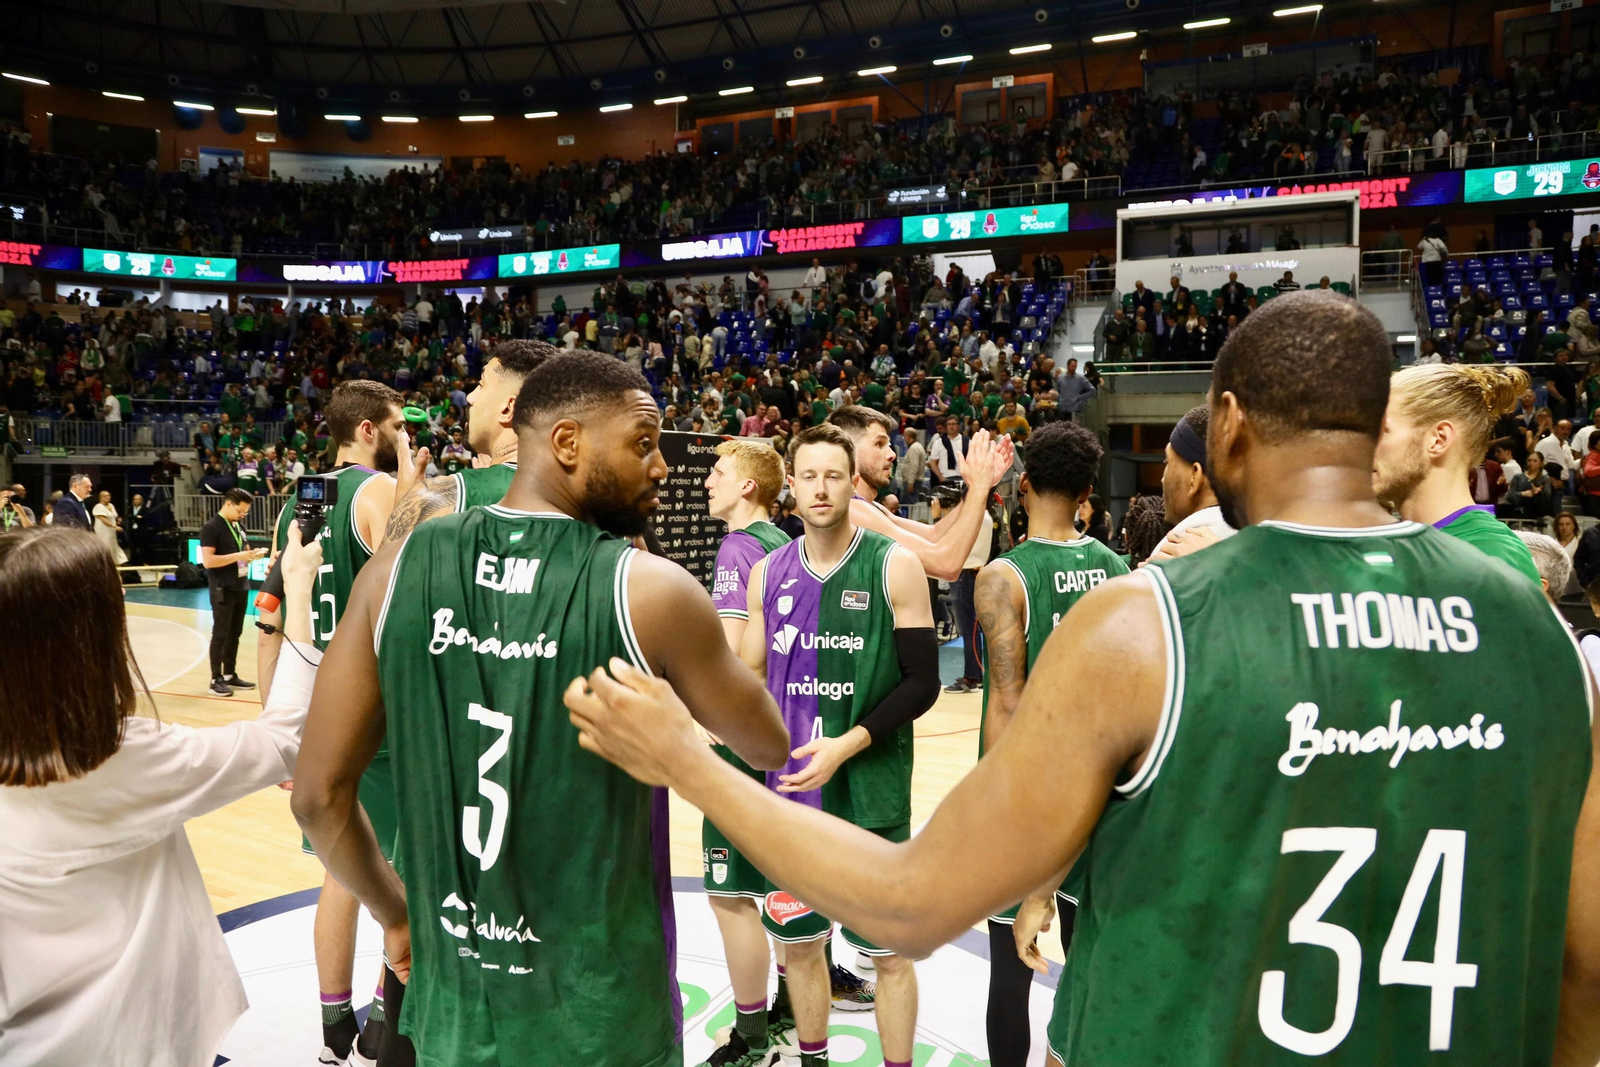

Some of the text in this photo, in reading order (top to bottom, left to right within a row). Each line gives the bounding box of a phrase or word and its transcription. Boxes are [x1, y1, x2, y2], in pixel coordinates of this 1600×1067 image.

[1527, 161, 1571, 177] JORNADA
[1533, 171, 1564, 196] 29
[1020, 214, 1037, 223] liga
[1020, 221, 1056, 231] endesa
[769, 222, 865, 243] CASADEMONT
[950, 219, 971, 240] 29
[661, 237, 745, 261] UNICAJA
[776, 233, 856, 253] ZARAGOZA
[282, 264, 366, 282] UNICAJA
[388, 258, 470, 273] CASADEMONT
[394, 269, 463, 283] ZARAGOZA
[688, 465, 708, 474] endesa
[686, 502, 706, 510] endesa
[668, 514, 689, 523] endesa
[684, 538, 705, 547] endesa
[475, 551, 541, 595] EJIM
[1054, 568, 1107, 594] CARTER
[1291, 592, 1479, 653] THOMAS
[800, 632, 864, 654] Unicaja
[462, 702, 513, 872] 3
[1258, 827, 1478, 1056] 34
